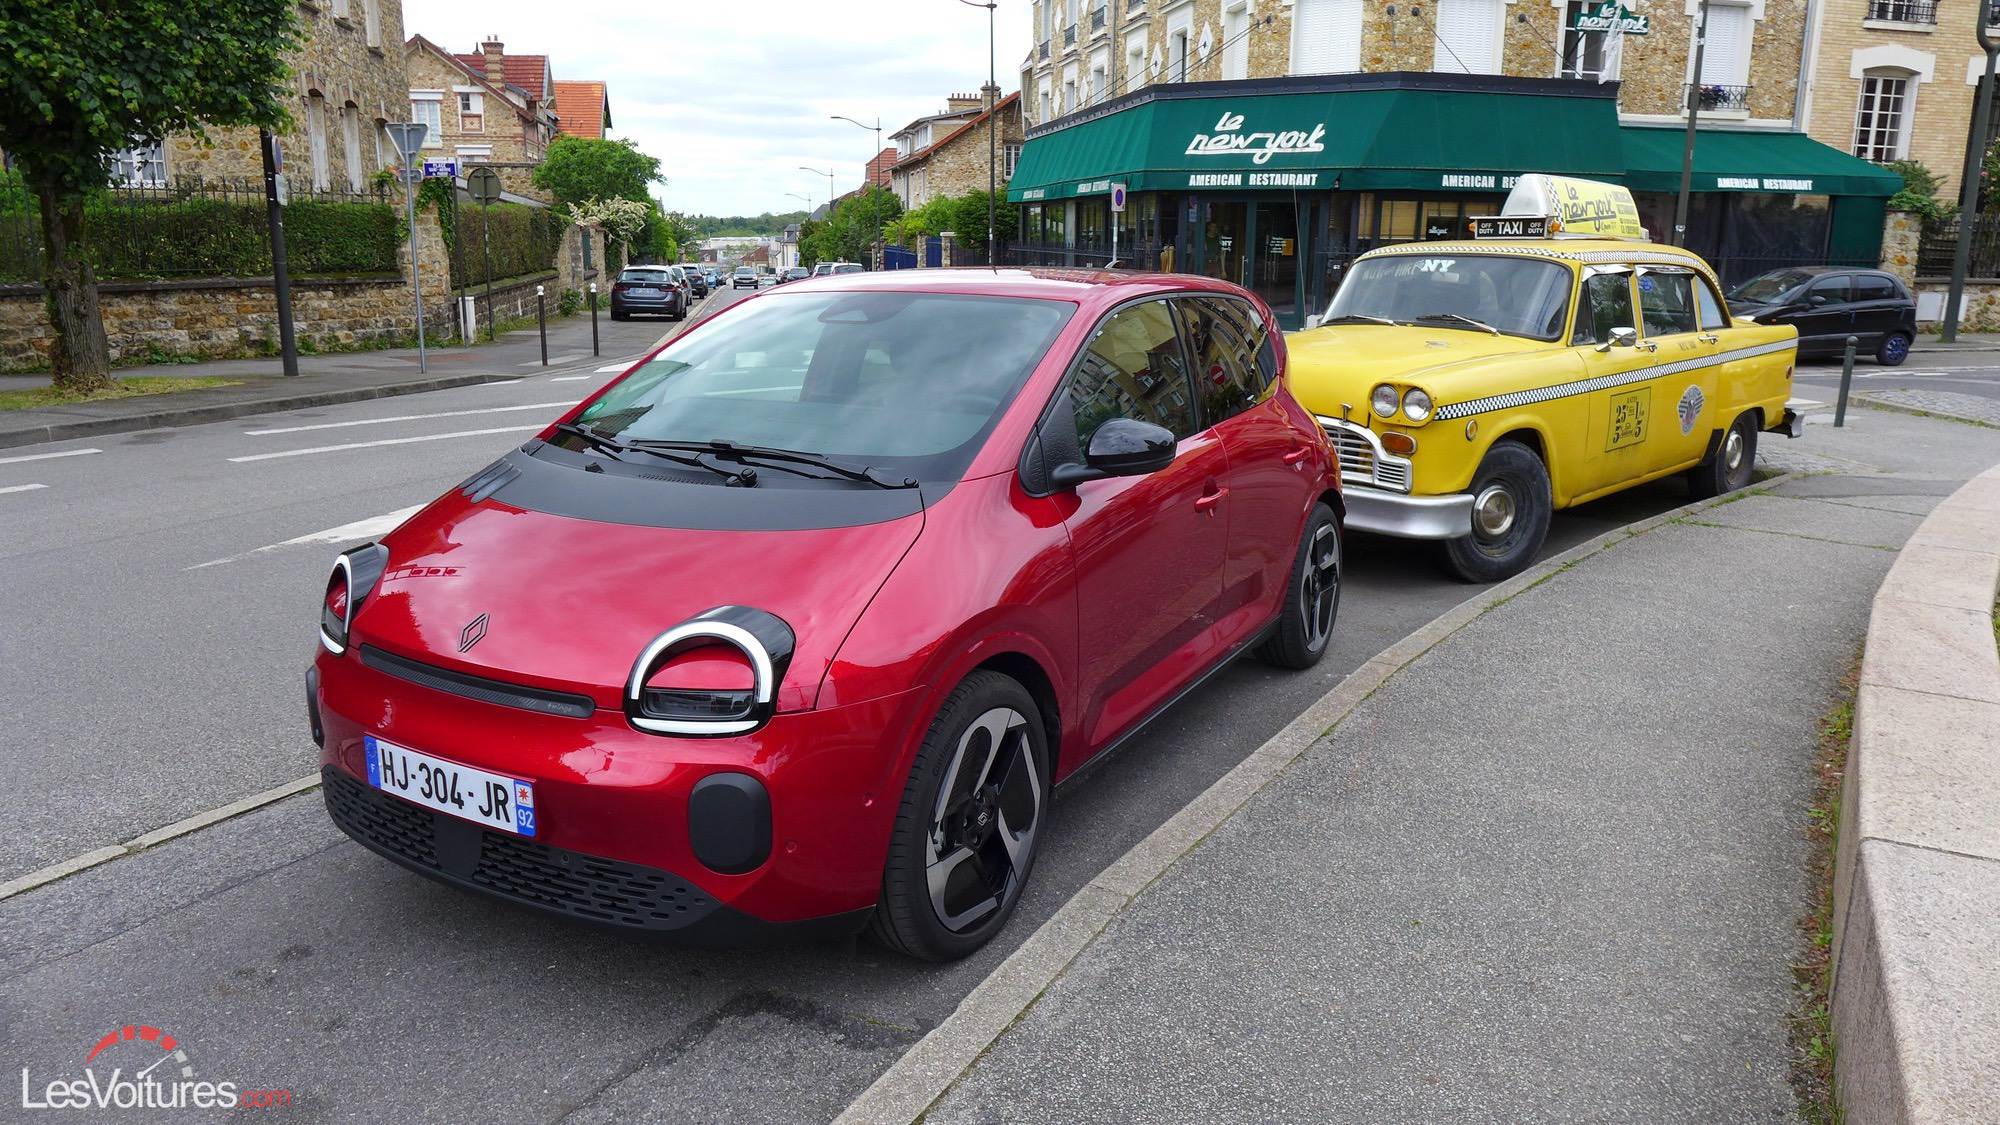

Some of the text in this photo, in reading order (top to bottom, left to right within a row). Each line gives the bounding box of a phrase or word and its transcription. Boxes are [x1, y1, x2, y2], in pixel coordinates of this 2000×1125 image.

[1189, 173, 1318, 186] AMERICAN RESTAURANT
[1442, 175, 1495, 188] AMERICAN
[1717, 177, 1813, 190] AMERICAN RESTAURANT
[1497, 221, 1523, 235] TAXI
[1421, 259, 1456, 272] NY
[380, 748, 511, 823] HJ-304-JR
[518, 808, 534, 829] 92
